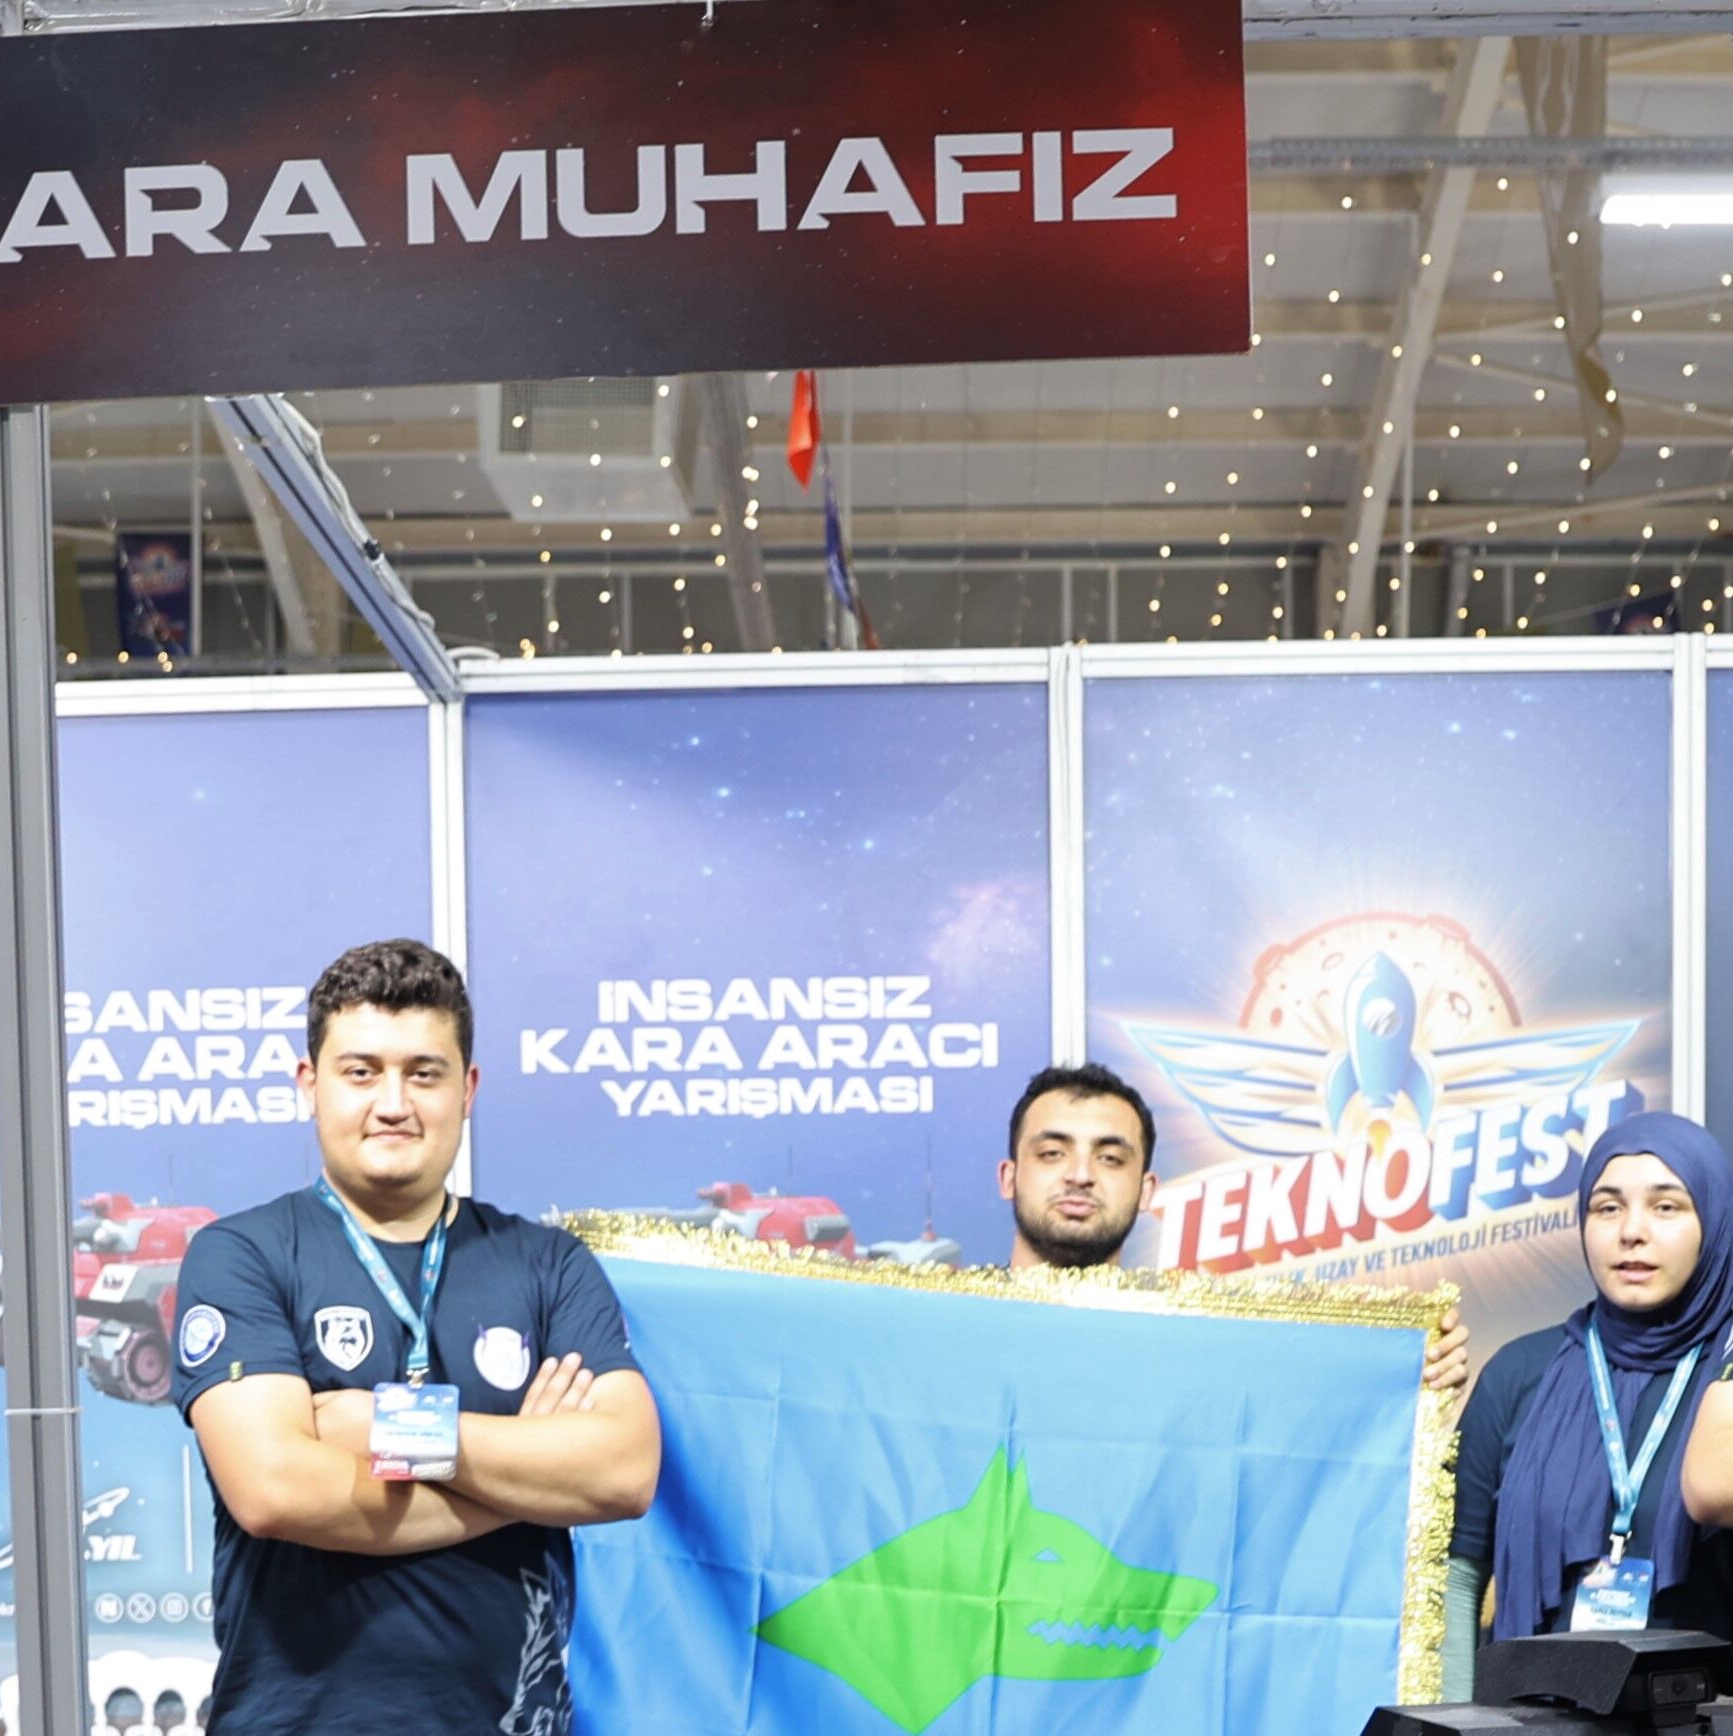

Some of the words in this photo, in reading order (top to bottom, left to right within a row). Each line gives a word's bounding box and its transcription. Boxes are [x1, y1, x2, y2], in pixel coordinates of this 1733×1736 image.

[406, 127, 1178, 246] MUHAFIZ
[598, 976, 931, 1024] İNSANSIZ
[137, 1034, 297, 1081] ARA
[520, 1026, 743, 1075] KARA
[759, 1023, 999, 1071] ARACI
[601, 1075, 933, 1119] YARIŞMASI
[1151, 1079, 1642, 1275] TEKNOFEST
[1315, 1258, 1357, 1283] UZAY
[1365, 1250, 1385, 1273] VE
[1391, 1224, 1487, 1267] TEKNOLOJİ
